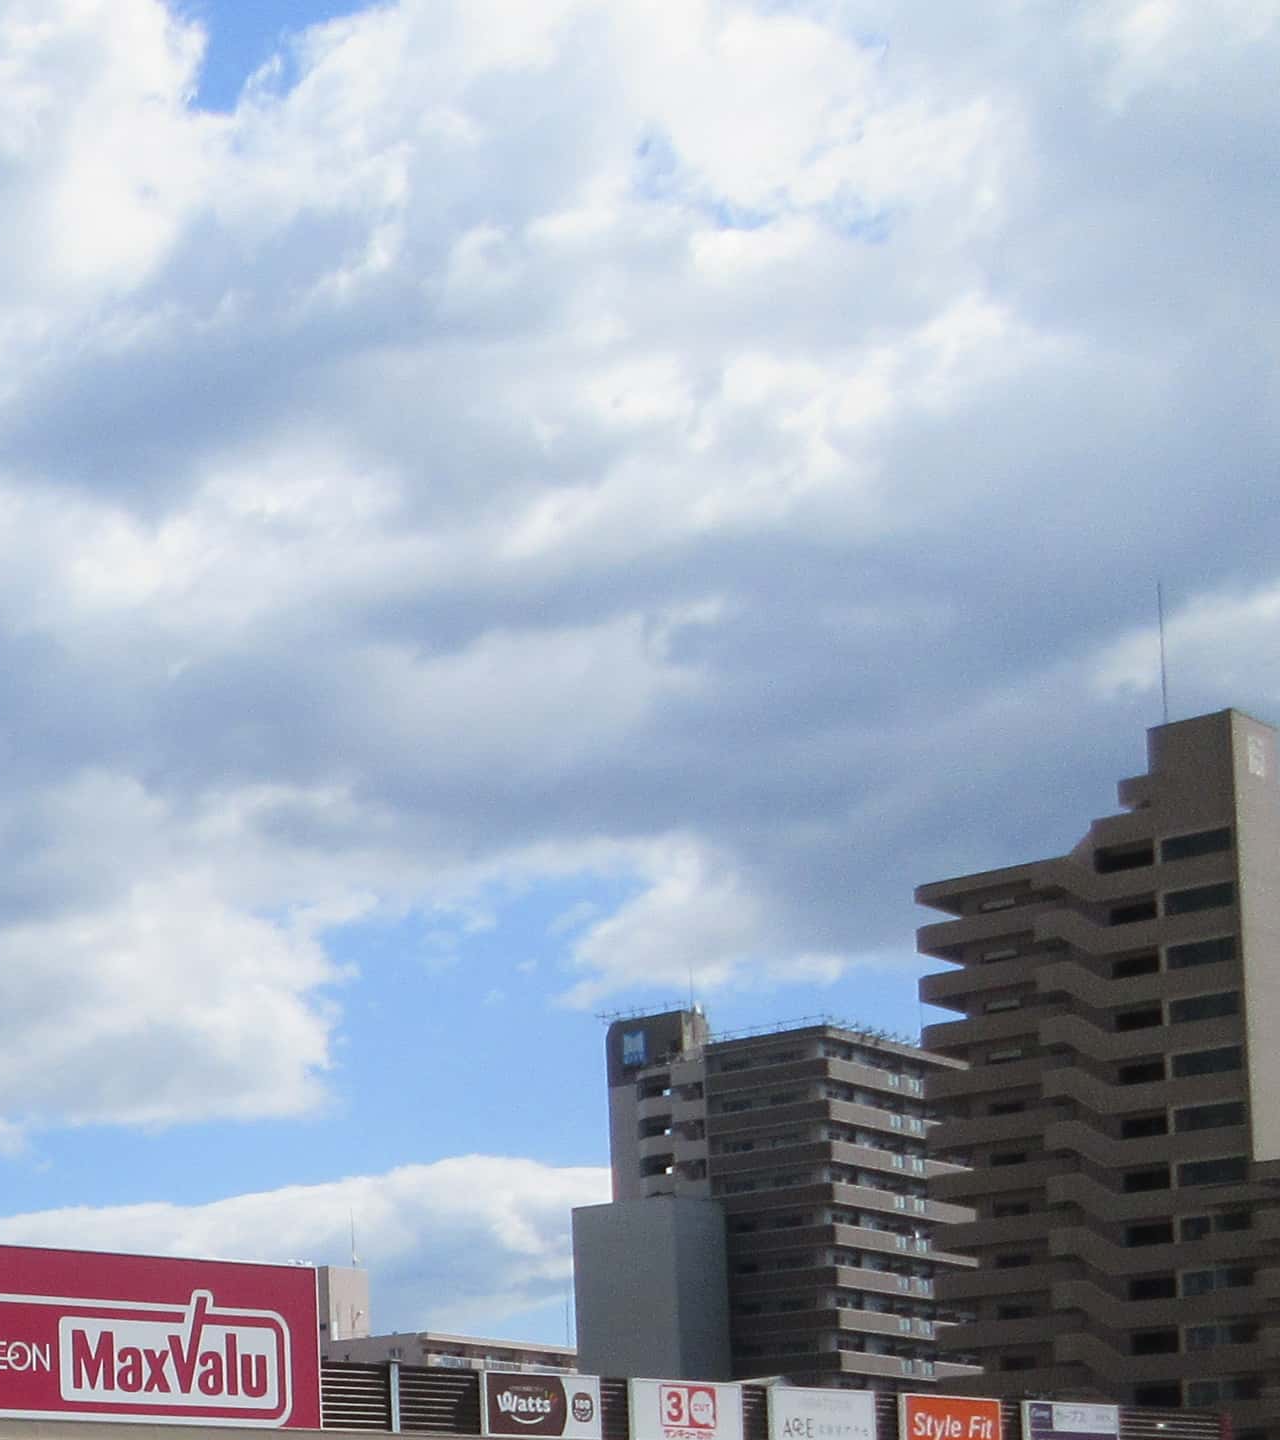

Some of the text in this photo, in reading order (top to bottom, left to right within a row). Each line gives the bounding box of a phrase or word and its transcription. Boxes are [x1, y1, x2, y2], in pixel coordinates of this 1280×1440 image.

[70, 1296, 269, 1398] MaxValu
[496, 1390, 552, 1414] Watts
[574, 1398, 591, 1411] 100
[968, 1415, 993, 1440] Fit
